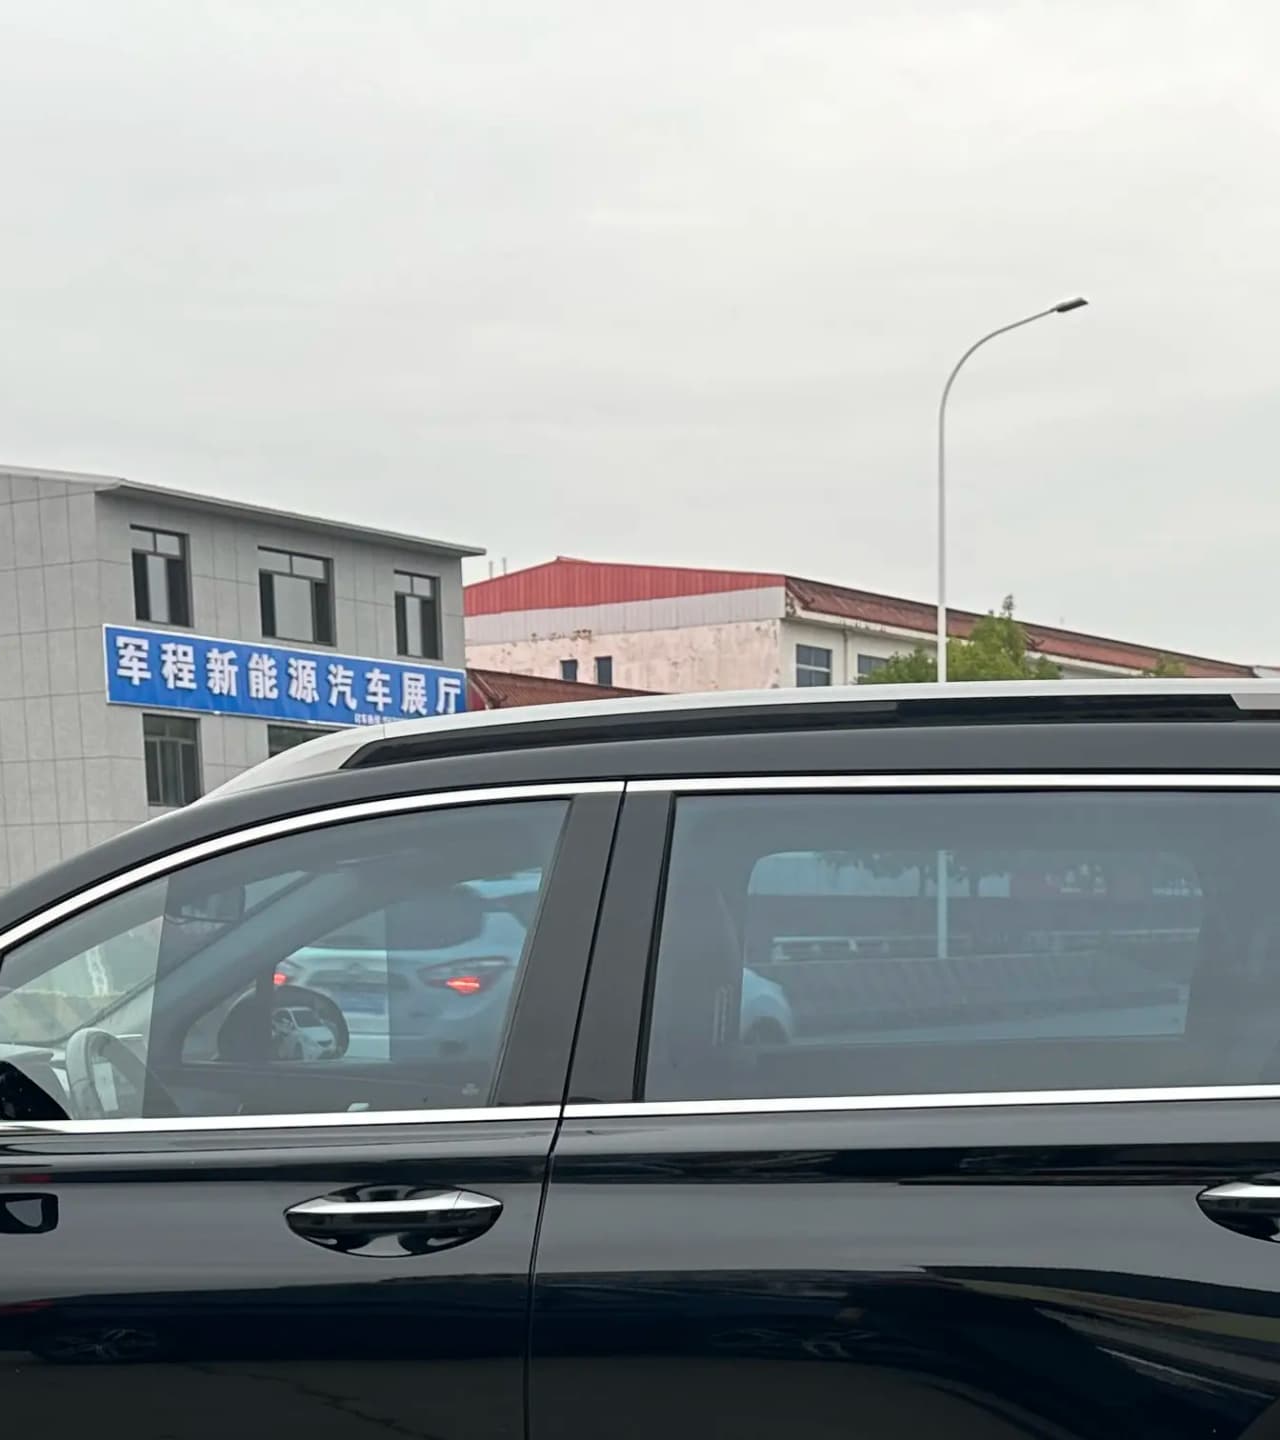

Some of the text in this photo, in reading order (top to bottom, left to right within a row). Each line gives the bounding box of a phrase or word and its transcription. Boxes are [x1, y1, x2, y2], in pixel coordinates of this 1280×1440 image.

[116, 636, 461, 715] 军程新能源汽车展厅
